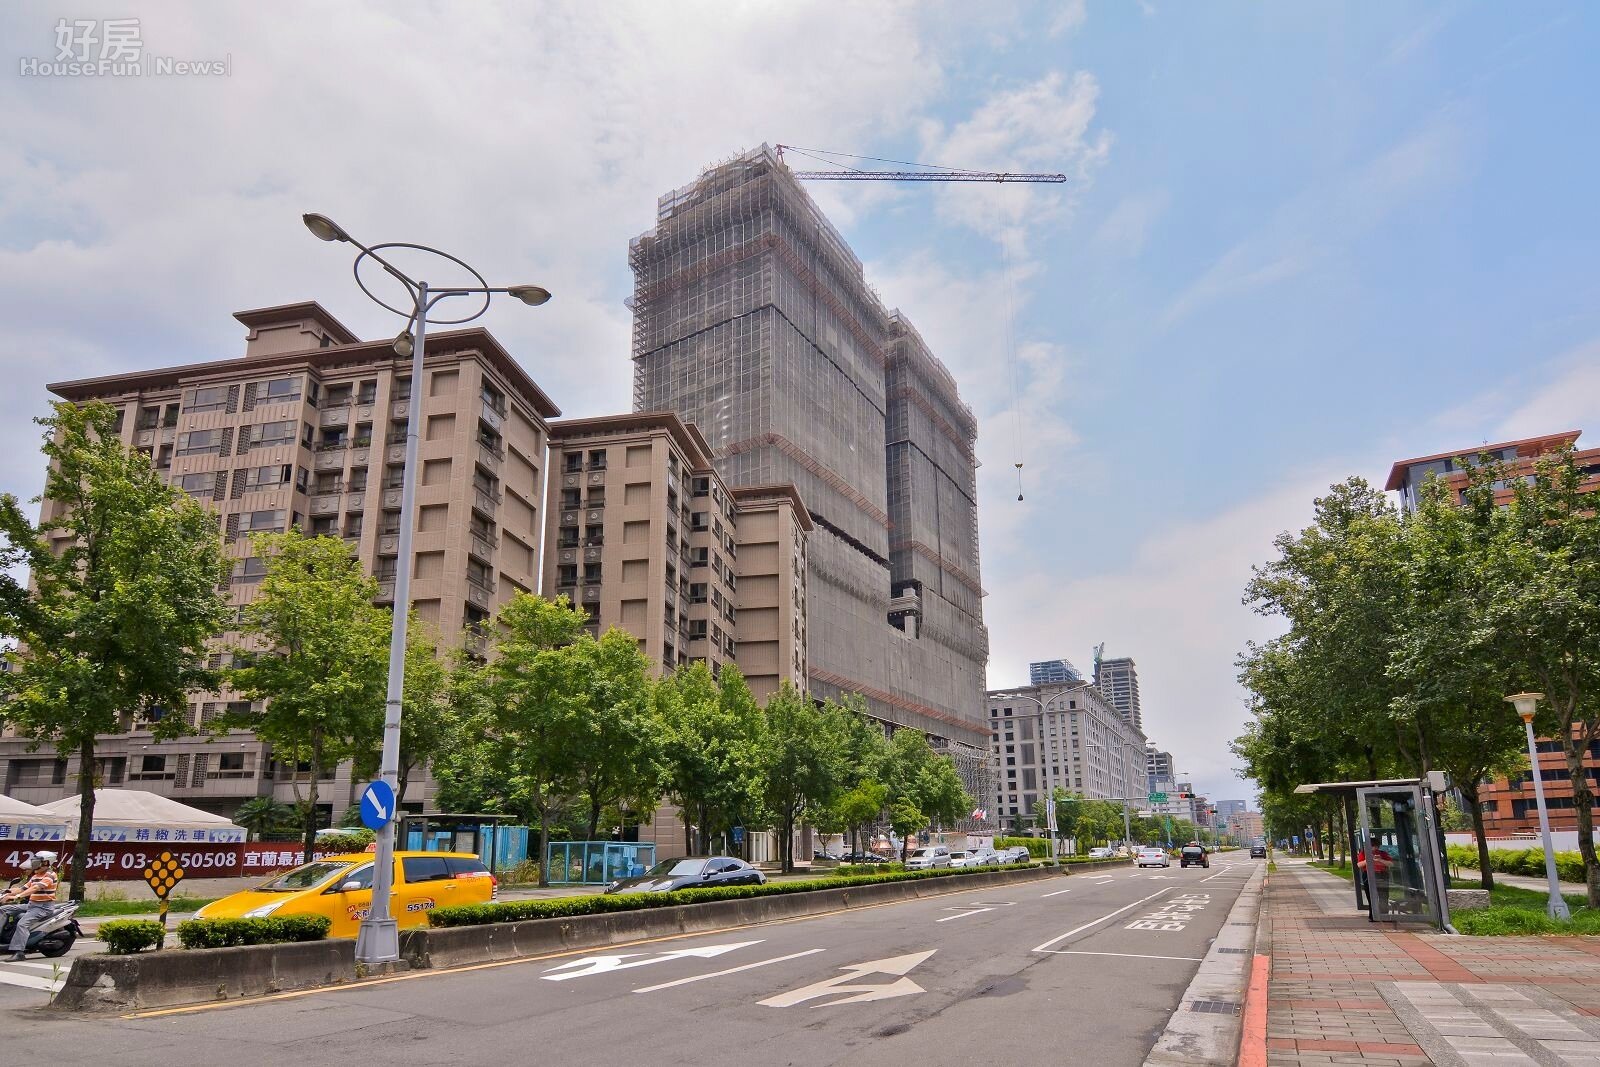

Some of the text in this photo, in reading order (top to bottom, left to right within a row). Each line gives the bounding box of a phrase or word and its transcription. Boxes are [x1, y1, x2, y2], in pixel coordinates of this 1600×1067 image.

[20, 827, 65, 840] 1971
[91, 828, 243, 842] 1971 精緻洗車 1971
[121, 851, 237, 869] 03-50508
[406, 902, 435, 912] 55178
